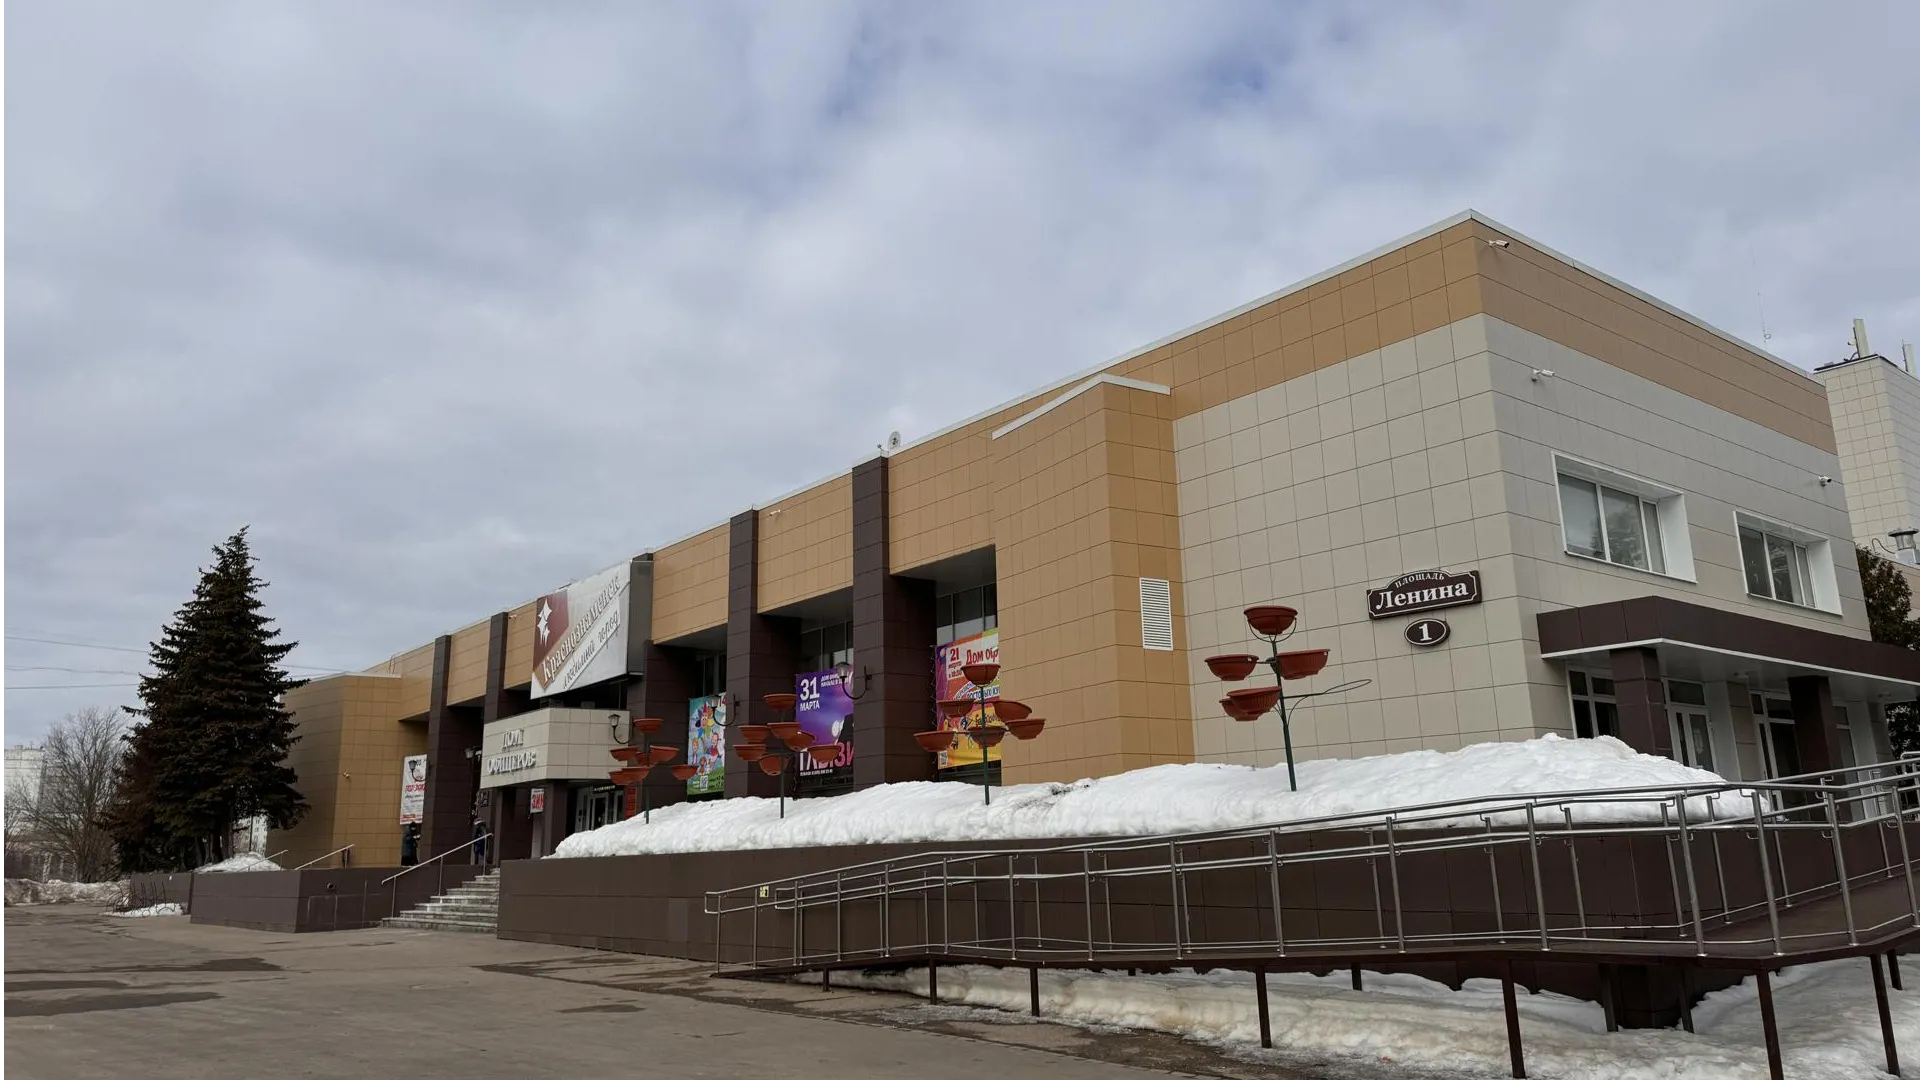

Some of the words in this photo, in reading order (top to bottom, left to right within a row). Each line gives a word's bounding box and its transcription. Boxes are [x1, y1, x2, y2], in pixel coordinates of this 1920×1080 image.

[1395, 572, 1445, 589] ПЛОЩАДЬ
[1375, 582, 1469, 610] Ленина
[541, 575, 621, 683] Краснознаменск
[1418, 623, 1432, 642] 1
[966, 649, 984, 665] Дом
[800, 677, 820, 701] 31
[799, 700, 820, 712] МАРТА
